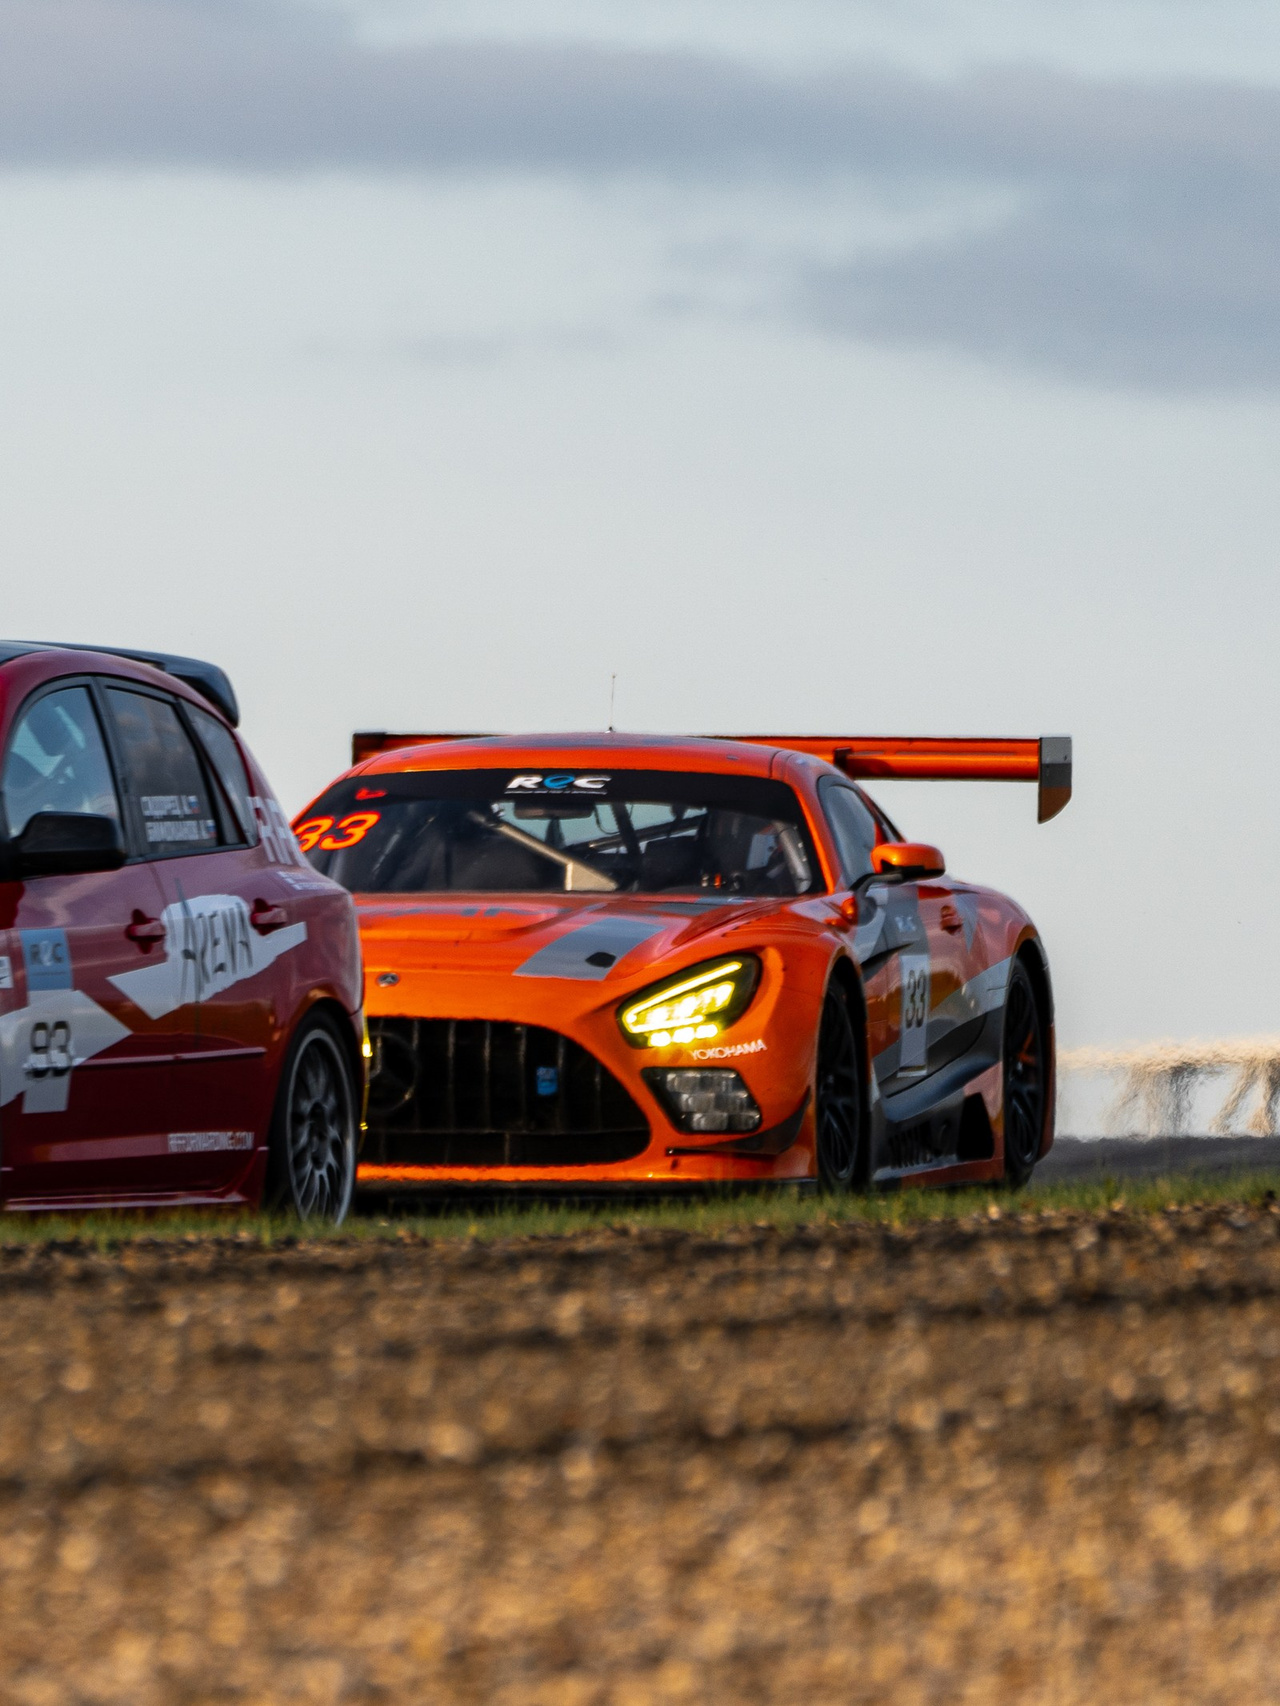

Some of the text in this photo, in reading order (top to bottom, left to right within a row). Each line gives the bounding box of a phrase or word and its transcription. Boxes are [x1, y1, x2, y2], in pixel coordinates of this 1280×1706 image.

[293, 810, 381, 852] 33
[905, 969, 927, 1029] 33
[29, 1020, 71, 1079] 93
[691, 1038, 768, 1060] YOKOHAMA
